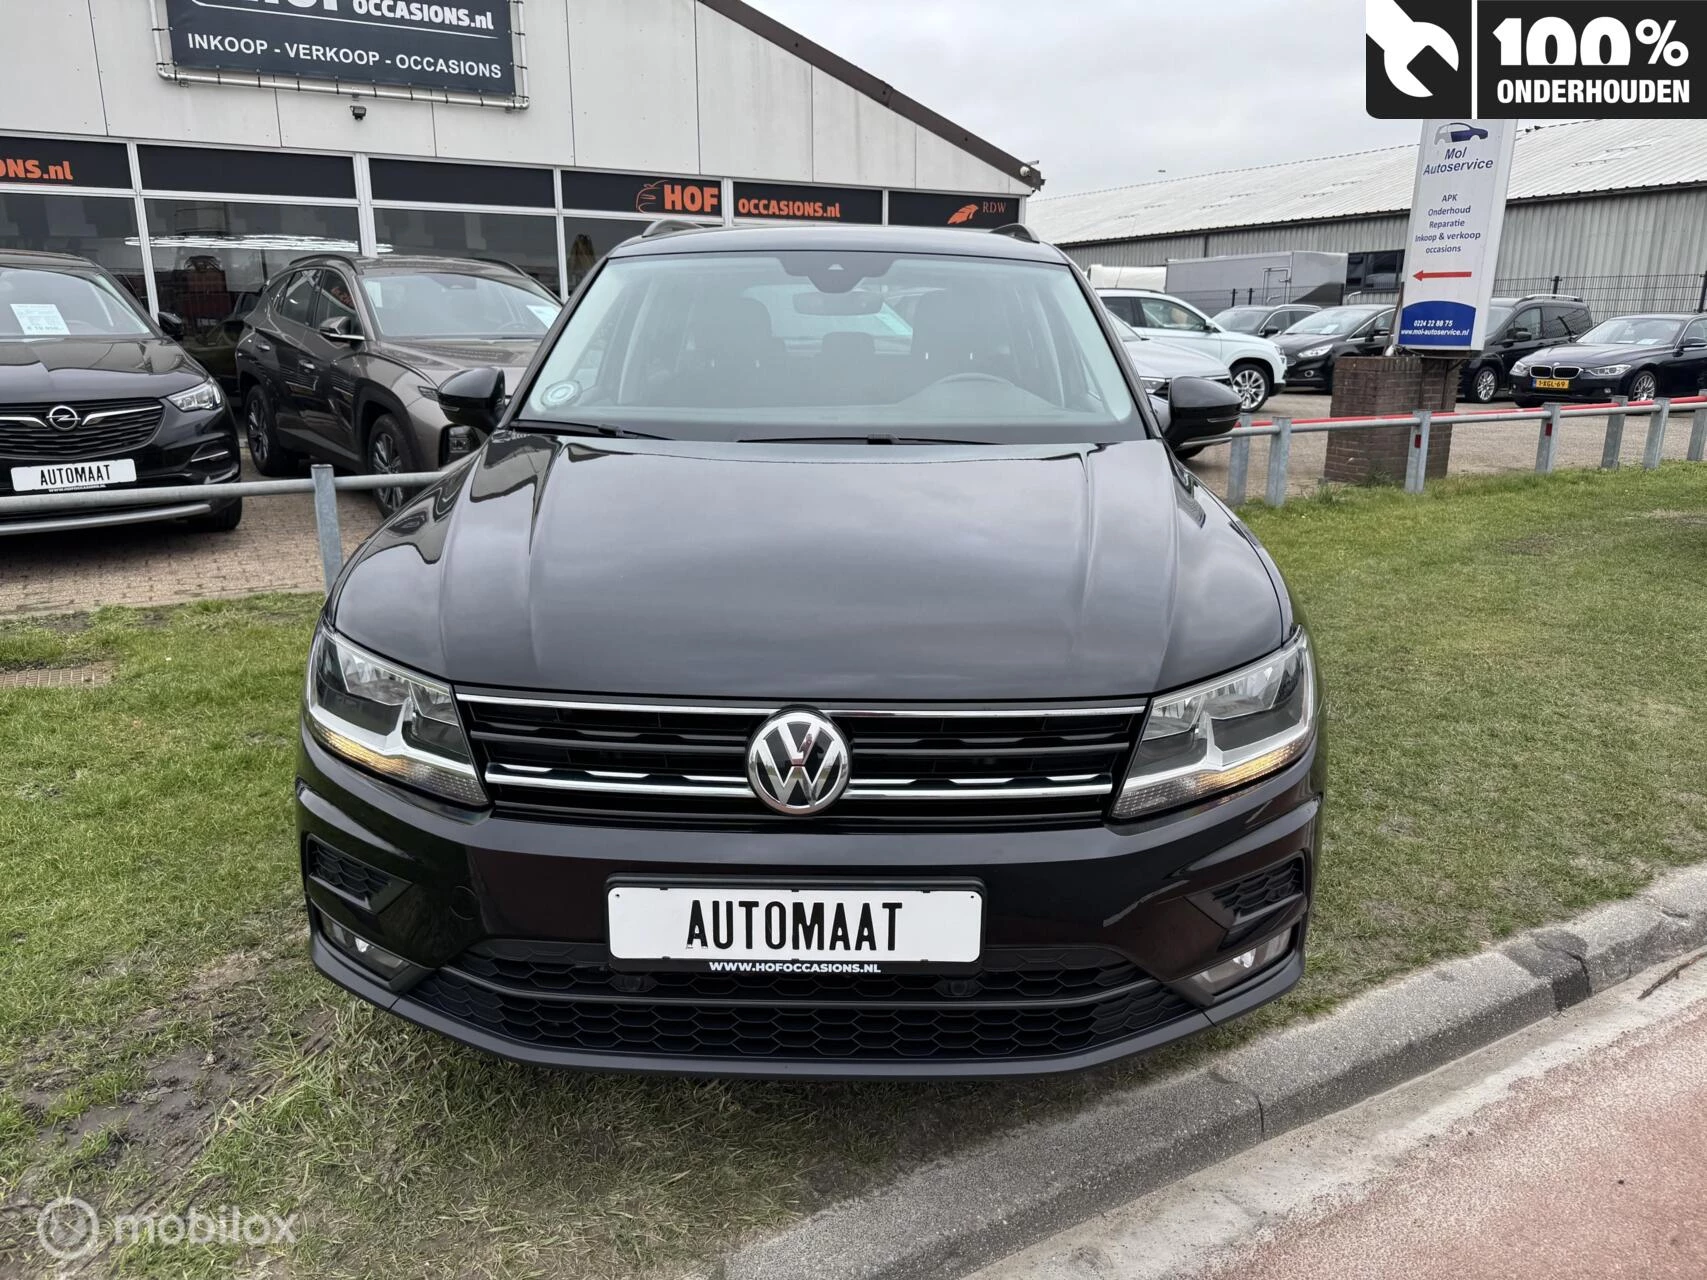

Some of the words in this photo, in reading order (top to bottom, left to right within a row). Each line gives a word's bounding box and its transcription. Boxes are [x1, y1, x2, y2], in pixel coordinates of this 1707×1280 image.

[352, 0, 494, 30] OCCASIONS.nl
[187, 32, 268, 55] INKOOP
[284, 42, 380, 66] VERKOOP
[395, 54, 502, 78] OCCASIONS
[1444, 146, 1468, 160] Mol
[1423, 158, 1494, 175] Autoservice
[664, 184, 719, 212] HOF
[738, 198, 841, 218] OCCASIONS.nl
[1442, 193, 1458, 202] APK
[982, 201, 1007, 213] RDW
[1428, 205, 1471, 216] Onderhoud
[1429, 219, 1465, 229] Reparatie
[1415, 234, 1437, 242] Inkoop
[1438, 232, 1445, 241] &
[1446, 231, 1481, 241] verkoop
[1425, 244, 1461, 254] occasions
[40, 464, 111, 486] AUTOMAAT
[686, 899, 903, 951] AUTOMAAT
[708, 961, 882, 974] WWW.HOFOCCASIONS.NL
